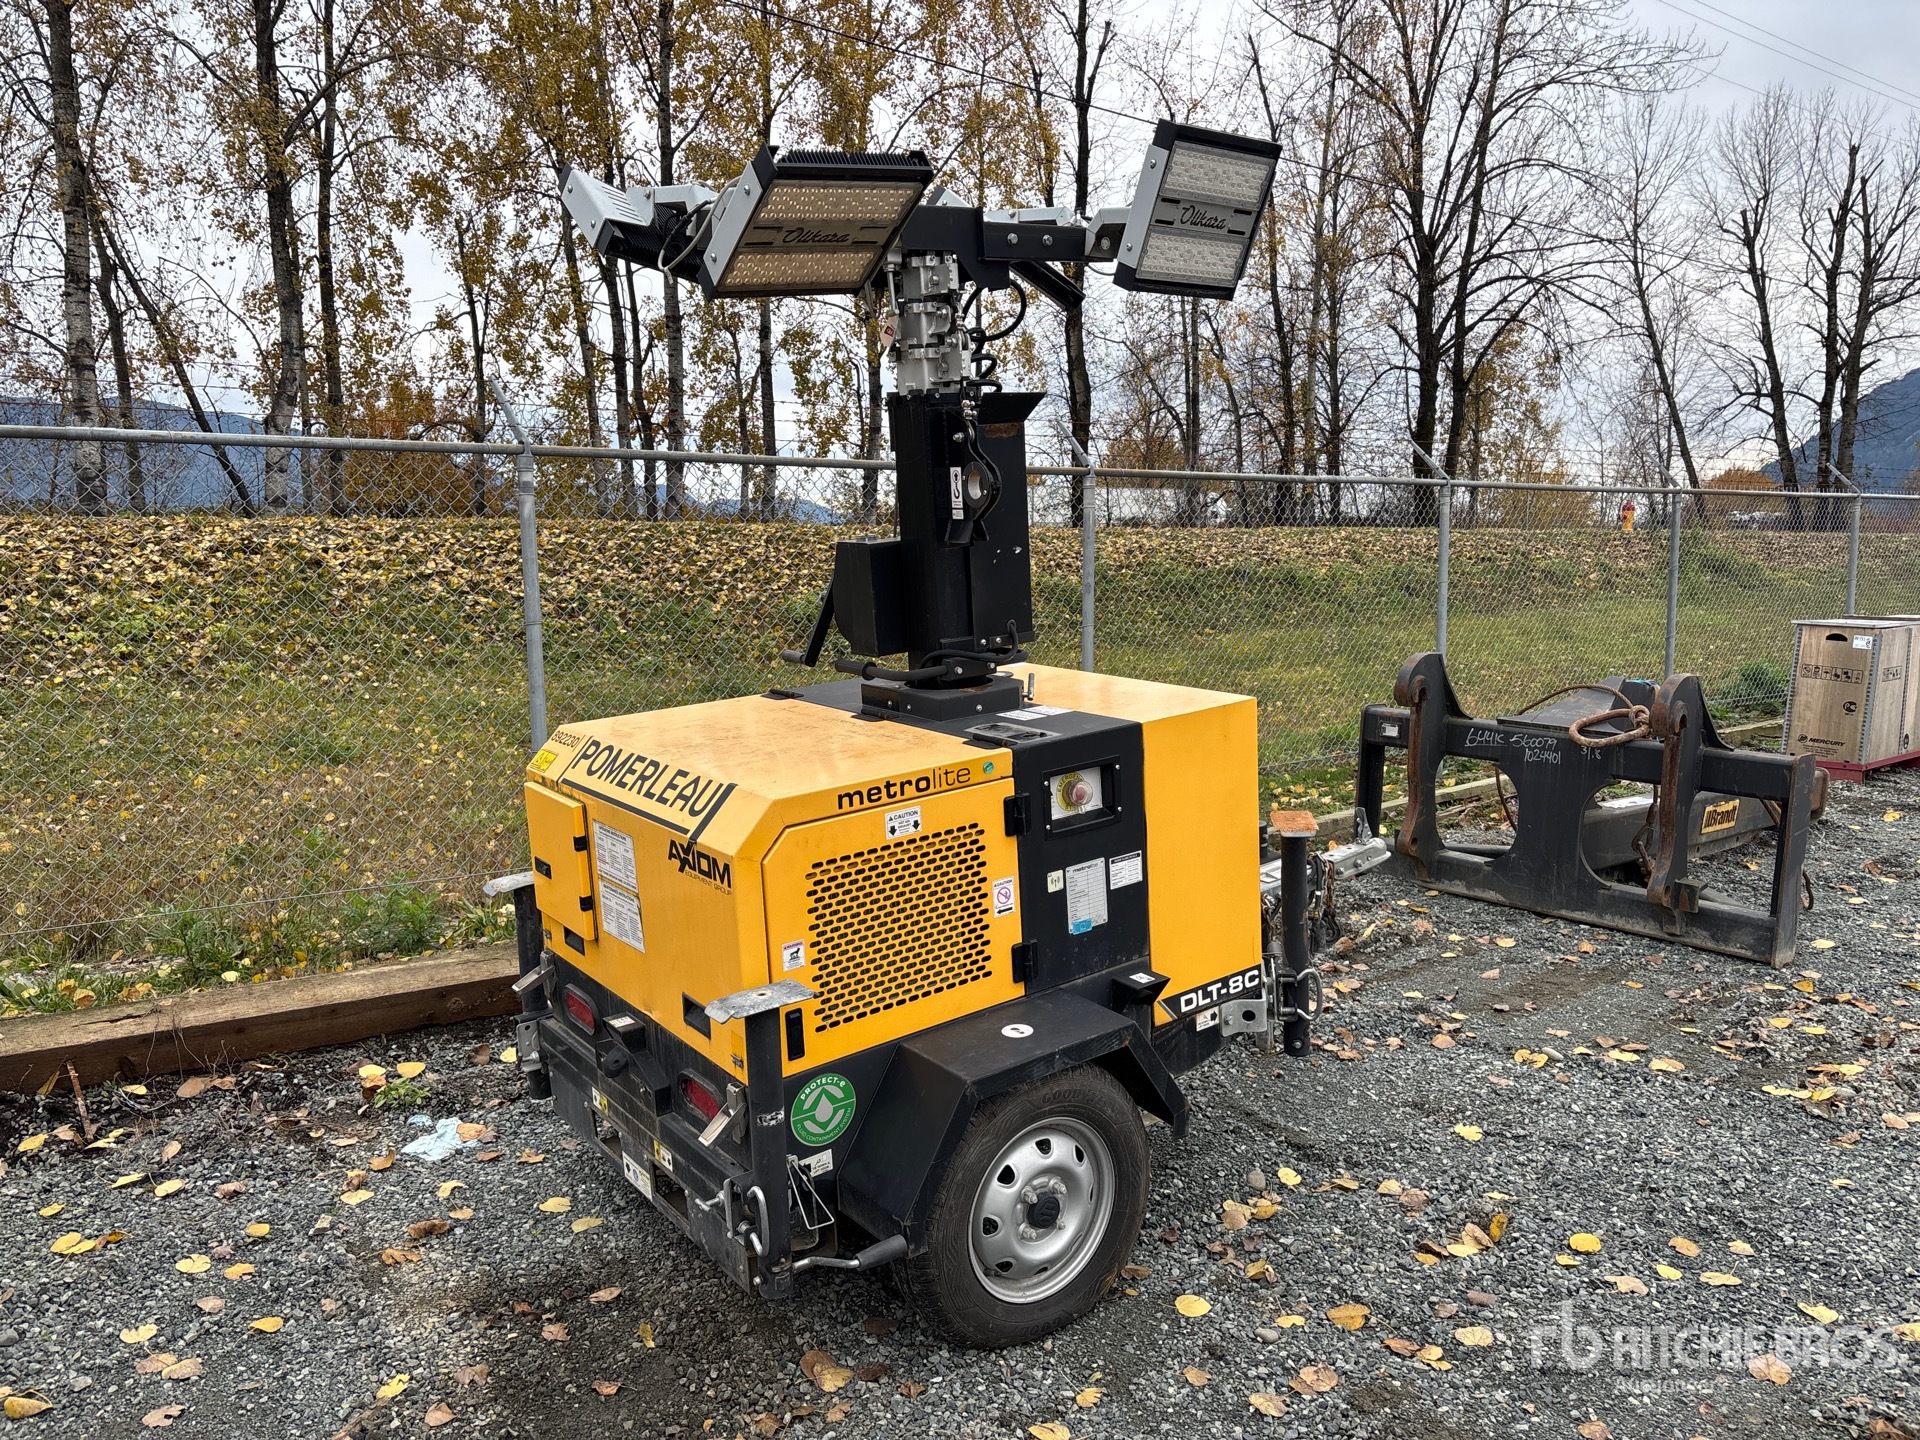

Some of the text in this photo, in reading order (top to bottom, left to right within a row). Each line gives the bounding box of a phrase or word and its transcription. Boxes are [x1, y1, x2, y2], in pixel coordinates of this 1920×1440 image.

[1523, 748, 1561, 765] 1024401
[1808, 737, 1846, 747] MERCURY
[571, 739, 724, 817] POMERLEAU
[836, 767, 971, 810] metrolite
[893, 810, 919, 821] CAUTION
[667, 838, 732, 889] AXIOM
[1180, 969, 1260, 1013] DLT-8C
[796, 1107, 852, 1142] FLUID CONTAINMENT SYSTEM
